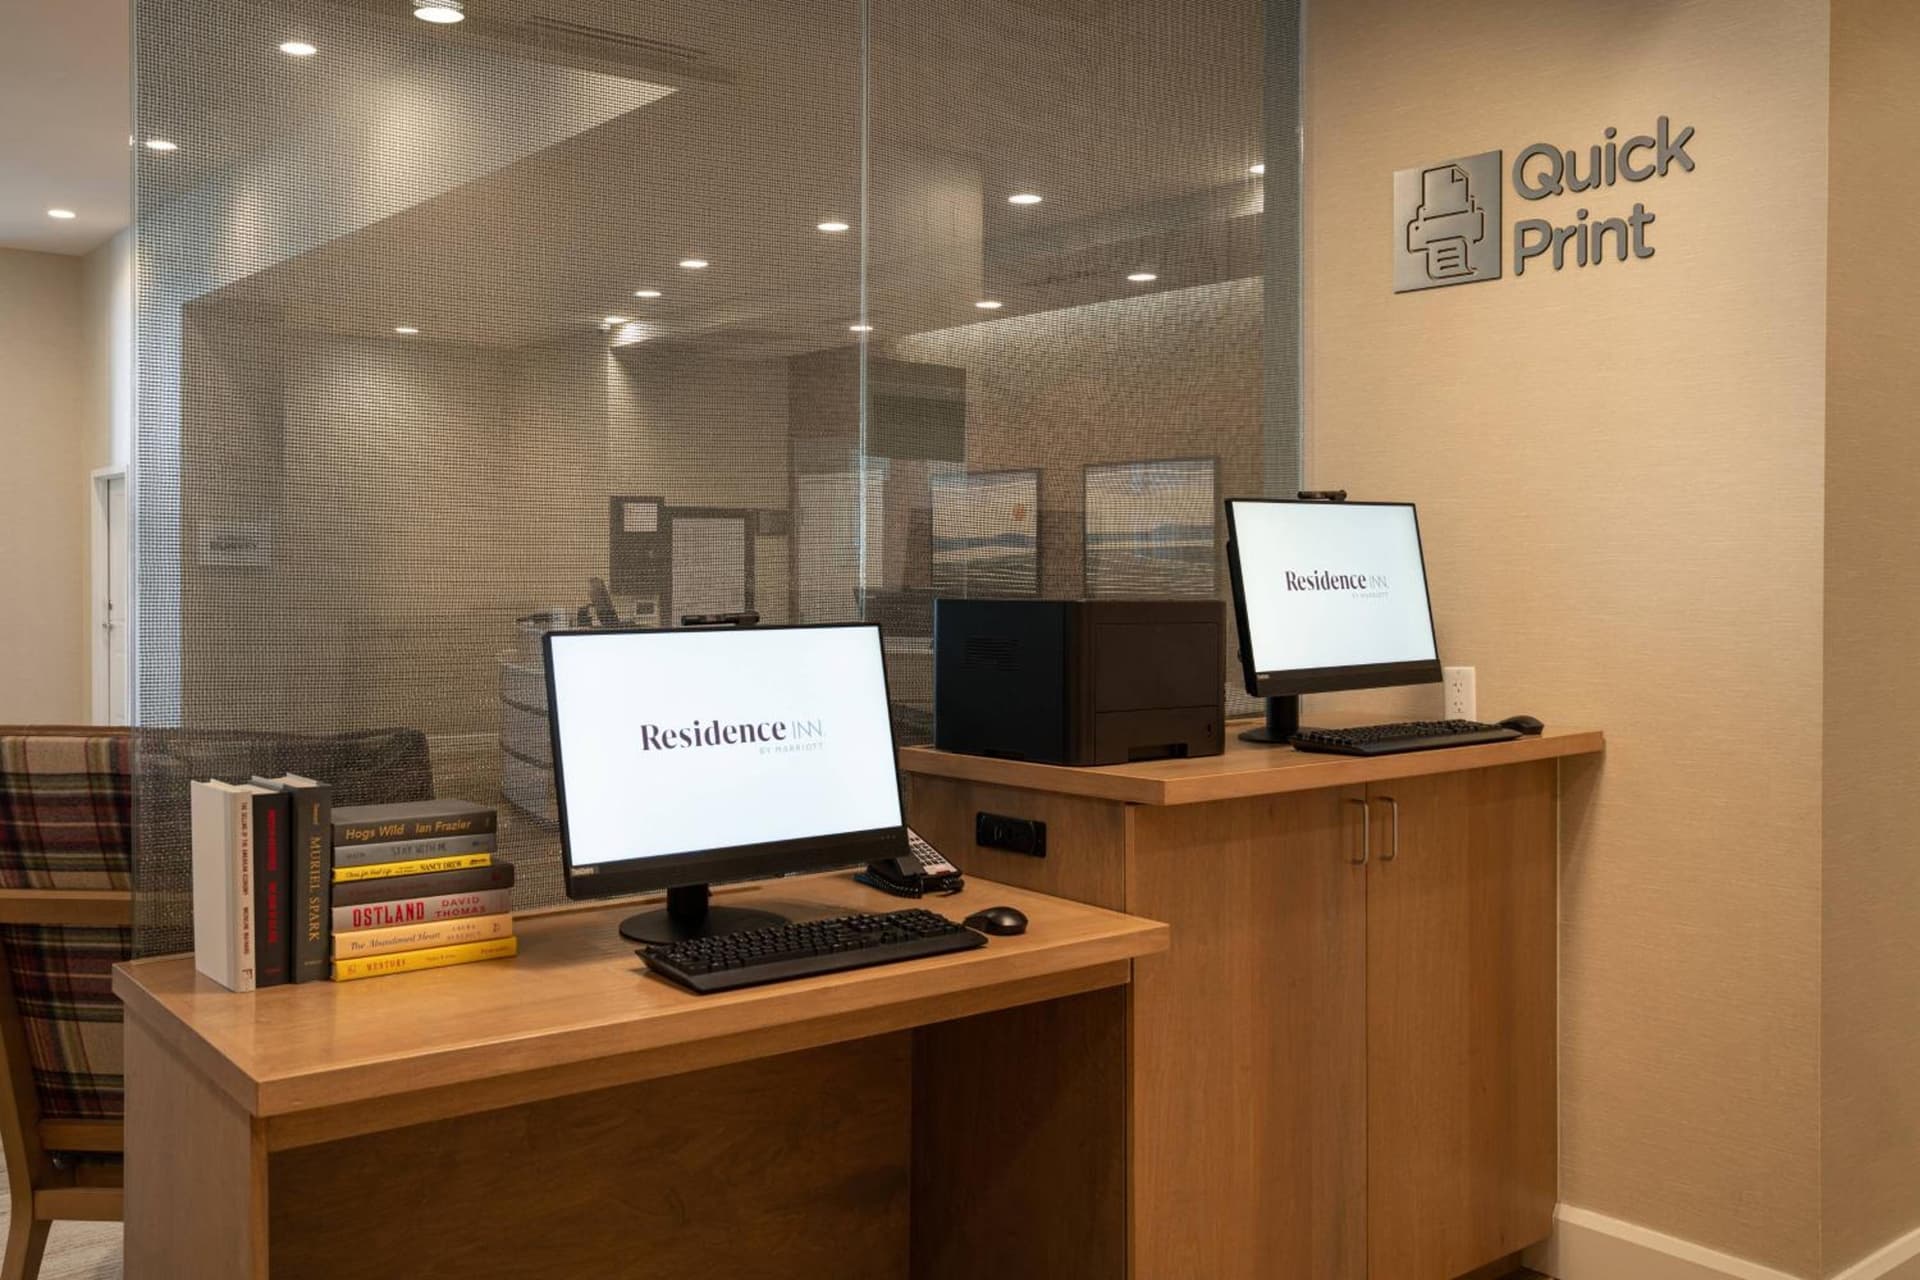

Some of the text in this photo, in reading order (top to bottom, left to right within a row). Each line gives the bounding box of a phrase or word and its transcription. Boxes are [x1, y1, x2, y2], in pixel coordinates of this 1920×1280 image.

[1512, 115, 1696, 201] Quick
[1513, 203, 1656, 276] Print
[1285, 569, 1367, 591] Residence
[640, 719, 823, 751] Residence INN
[759, 742, 824, 755] BY MARRIOTT
[345, 819, 472, 841] Hogs Wild Ian Frazier
[310, 836, 321, 892] MURIEL
[352, 901, 425, 928] OSTLAND
[434, 905, 486, 918] THOMAS
[442, 896, 480, 907] DAVID
[308, 896, 320, 942] SPARK
